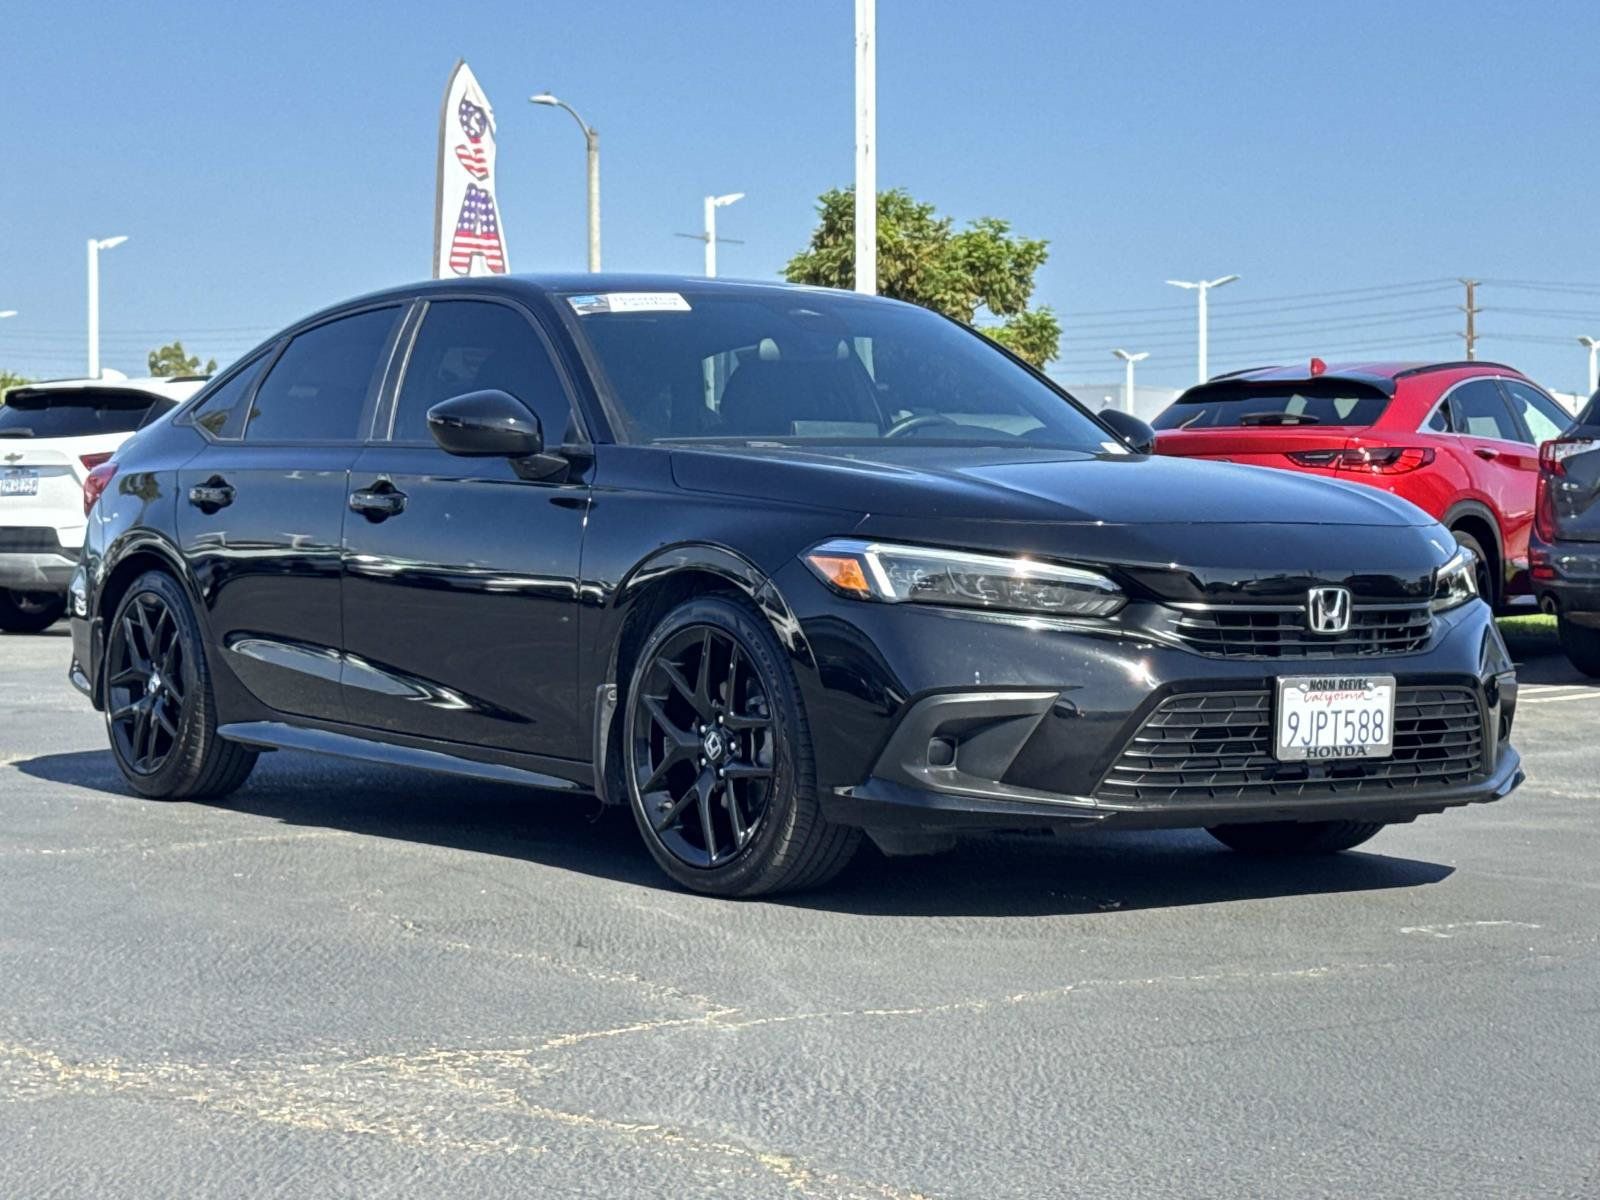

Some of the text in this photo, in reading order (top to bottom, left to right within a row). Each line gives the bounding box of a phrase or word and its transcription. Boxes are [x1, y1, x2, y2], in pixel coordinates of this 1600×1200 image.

[1309, 679, 1369, 691] NORM REEVES
[1304, 691, 1367, 707] California
[1287, 709, 1385, 747] 9JPT588
[1306, 746, 1368, 758] HONDA
